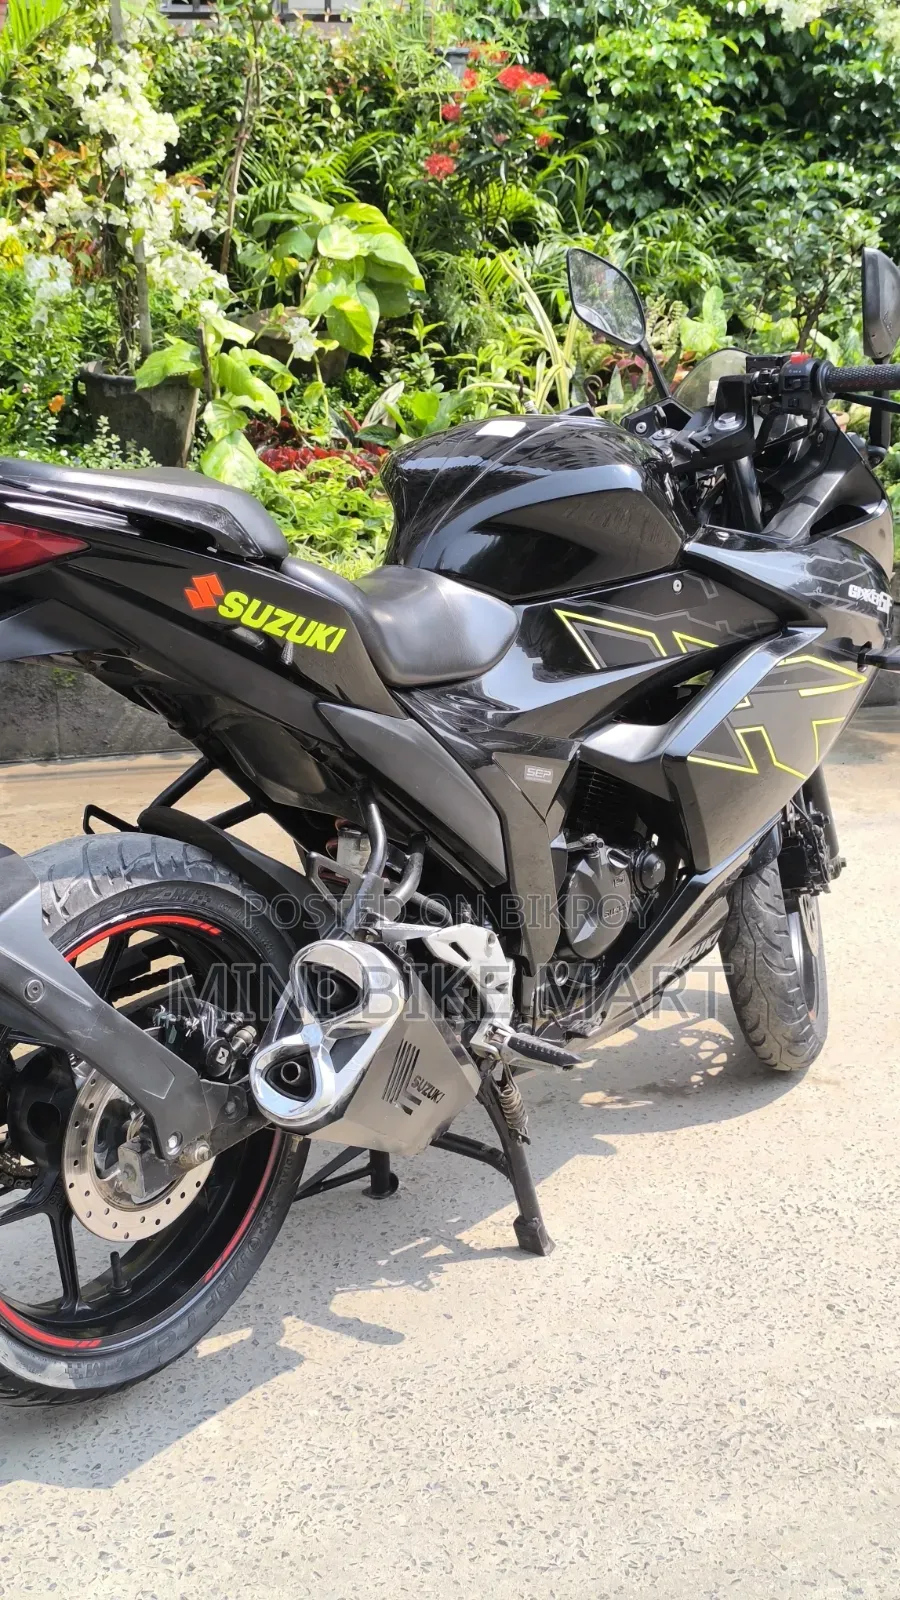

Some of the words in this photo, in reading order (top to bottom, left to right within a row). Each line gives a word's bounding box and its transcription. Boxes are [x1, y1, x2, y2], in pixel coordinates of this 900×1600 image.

[218, 590, 347, 653] SUZUKI
[526, 767, 552, 779] SEP
[411, 1074, 446, 1105] SUZUKI
